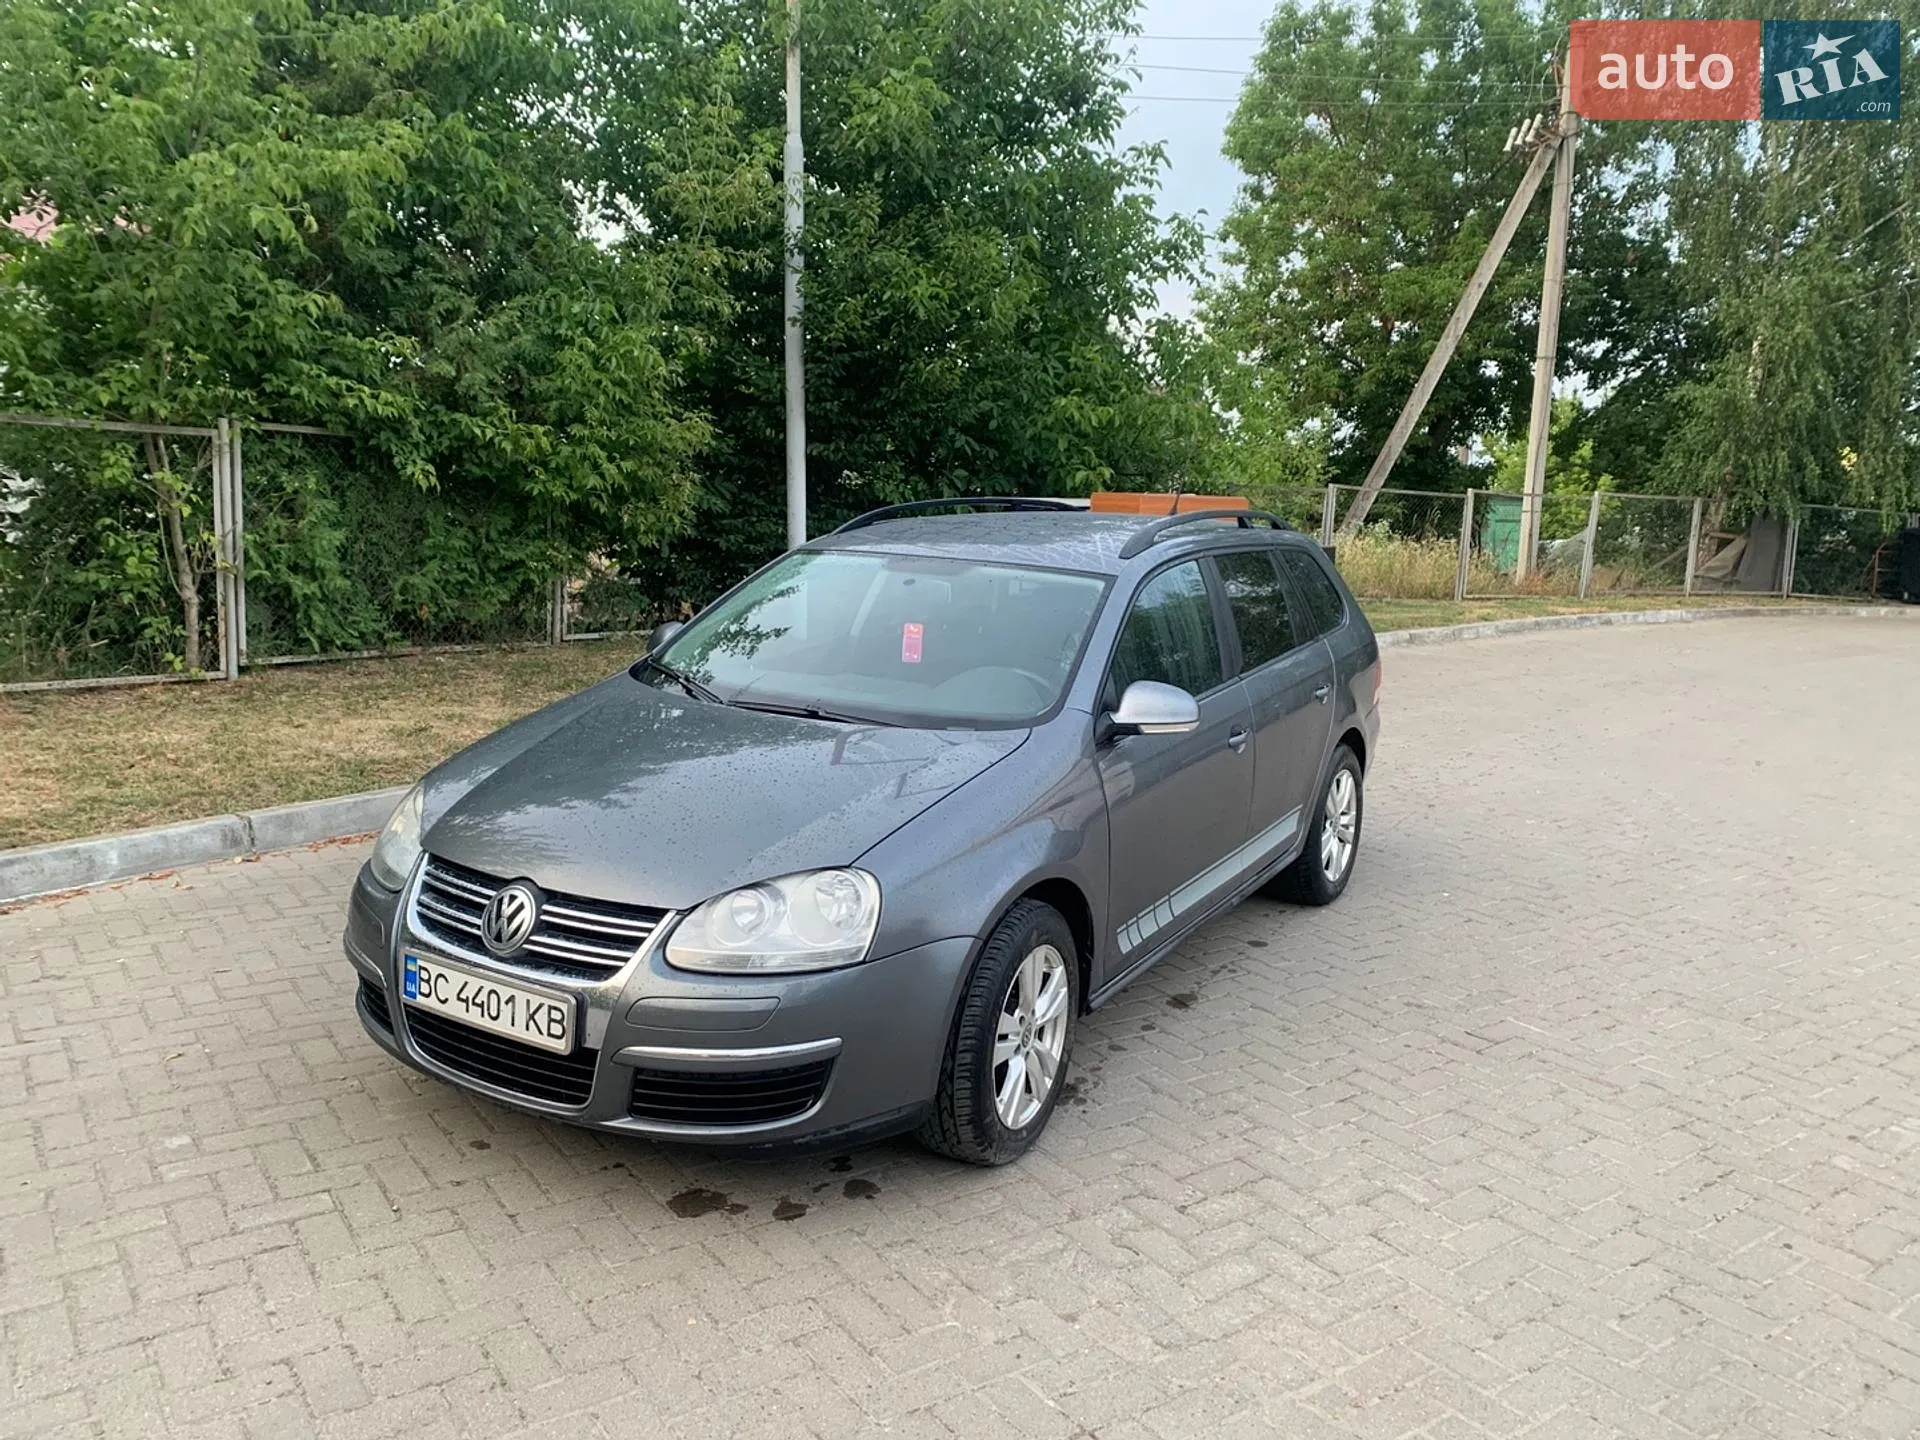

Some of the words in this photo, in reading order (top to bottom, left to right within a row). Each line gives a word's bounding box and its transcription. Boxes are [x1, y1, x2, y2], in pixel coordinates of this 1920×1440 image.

[406, 981, 417, 993] UA
[418, 965, 449, 1005] BC
[456, 981, 515, 1027] 4401
[525, 999, 567, 1040] KB
